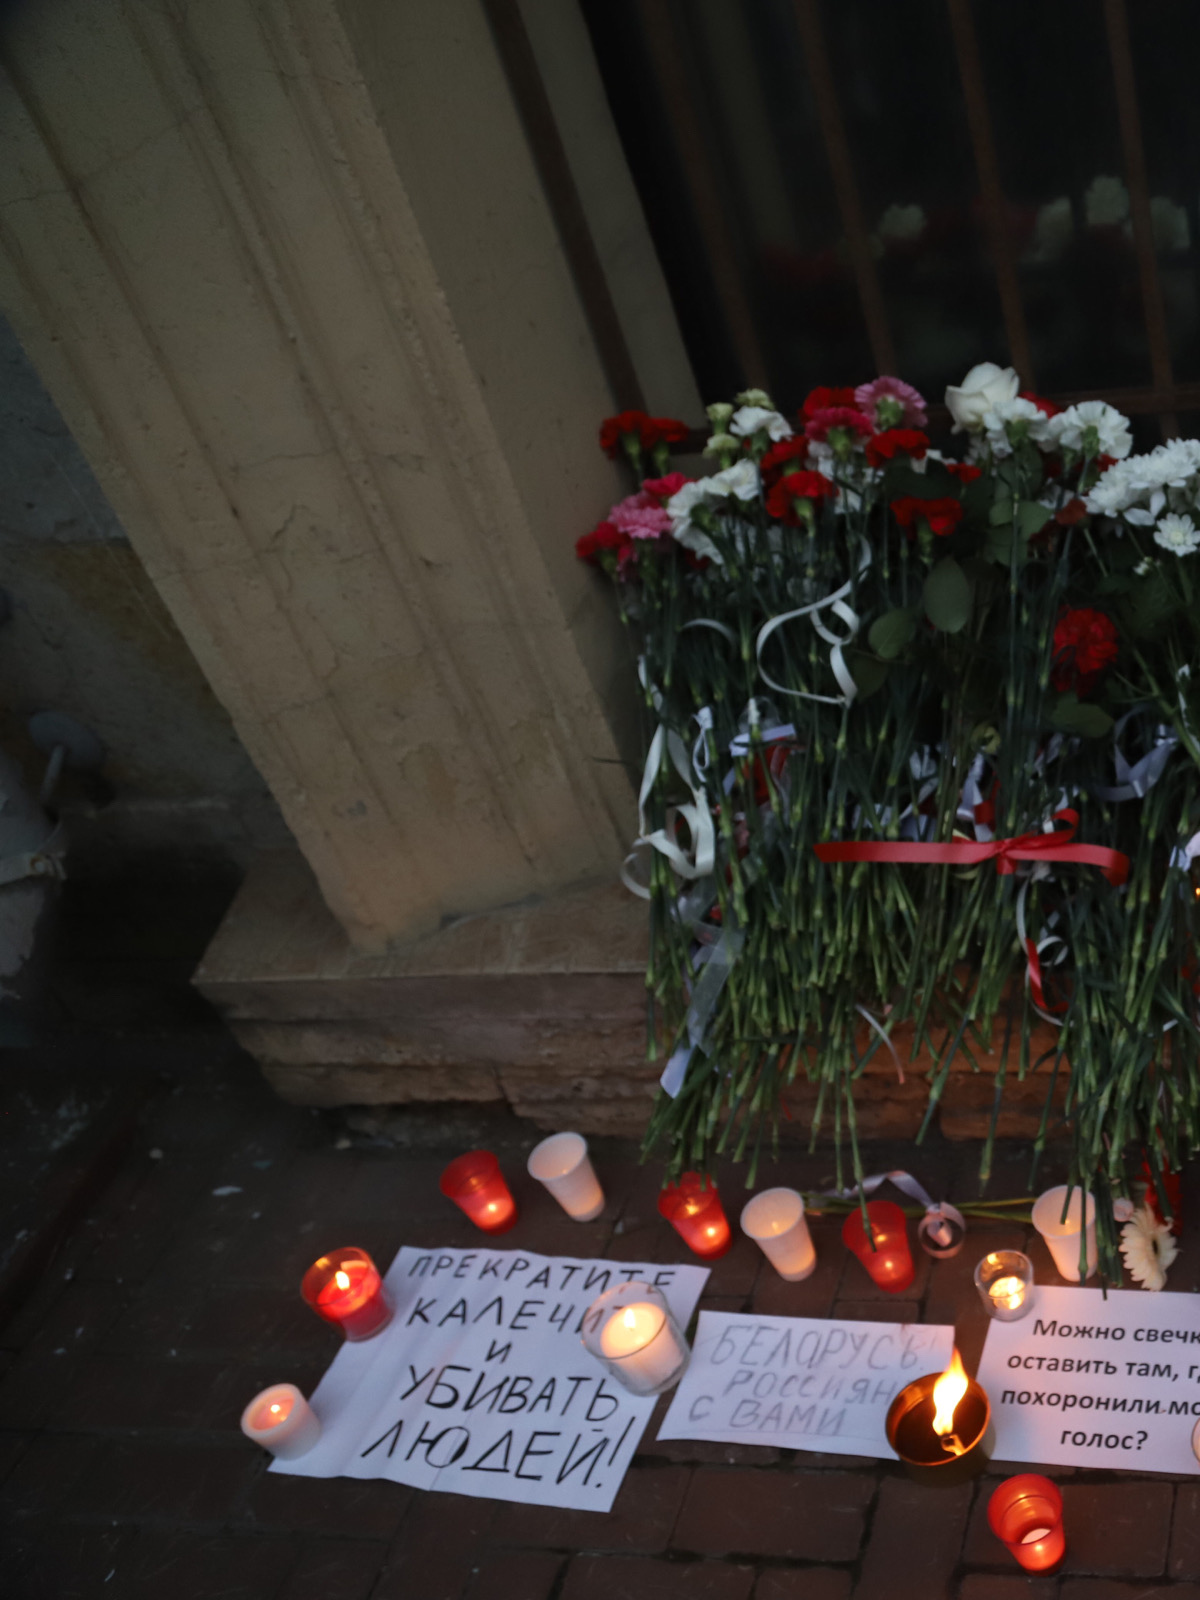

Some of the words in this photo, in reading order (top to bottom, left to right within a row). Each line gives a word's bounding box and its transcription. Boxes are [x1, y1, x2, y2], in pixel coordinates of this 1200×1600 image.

[408, 1255, 677, 1294] ПРЕКРАТИТЕ
[1032, 1319, 1126, 1341] Можно
[485, 1340, 511, 1363] И
[1007, 1354, 1118, 1375] оставить
[1125, 1361, 1179, 1382] там,
[400, 1365, 619, 1422] УБИВАТЬ
[723, 1369, 902, 1406] РОССИЯН
[1001, 1389, 1161, 1415] похоронили
[688, 1395, 714, 1421] С
[729, 1399, 847, 1436] ВАМИ
[361, 1416, 636, 1488] ЛЮДЕЙ!
[1060, 1430, 1148, 1450] голос?
